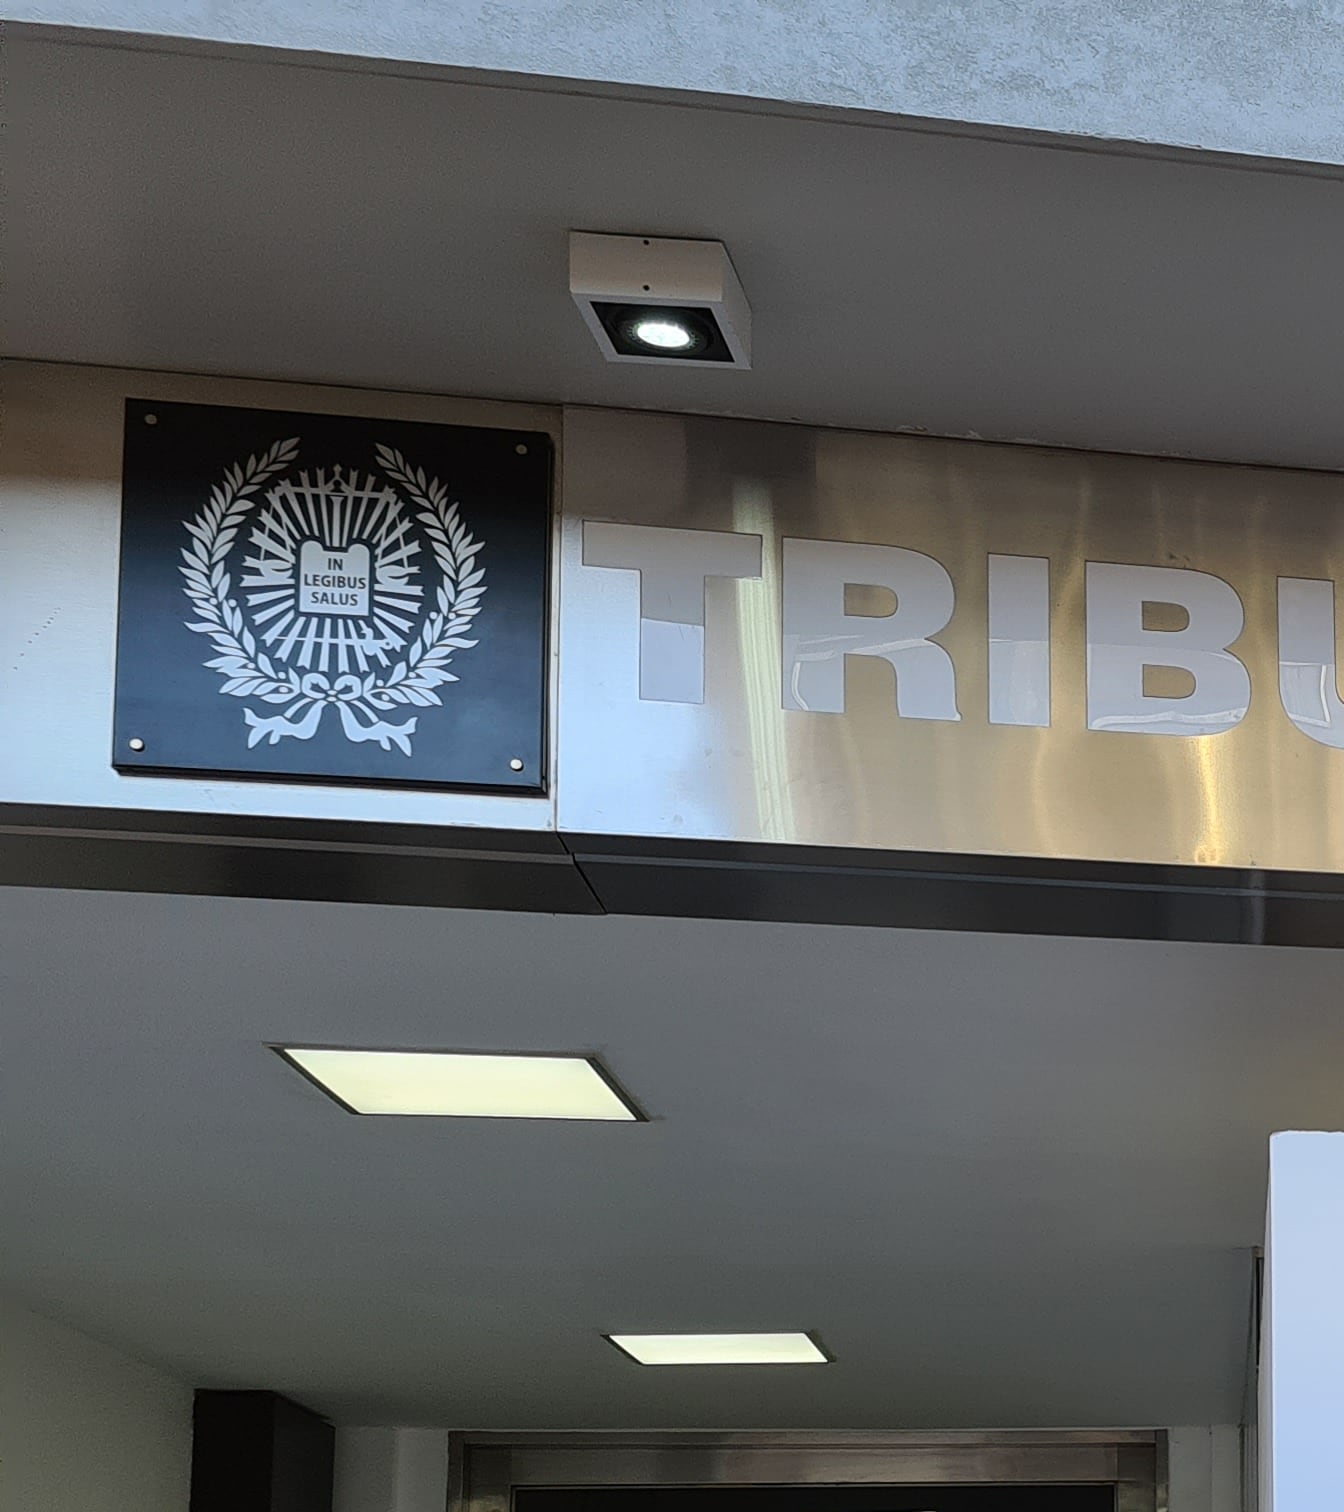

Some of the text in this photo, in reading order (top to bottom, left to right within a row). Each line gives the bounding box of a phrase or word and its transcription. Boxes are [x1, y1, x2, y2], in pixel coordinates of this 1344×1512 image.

[327, 557, 343, 571] IN
[304, 574, 366, 589] LEGIBUS
[311, 592, 358, 606] SALUS
